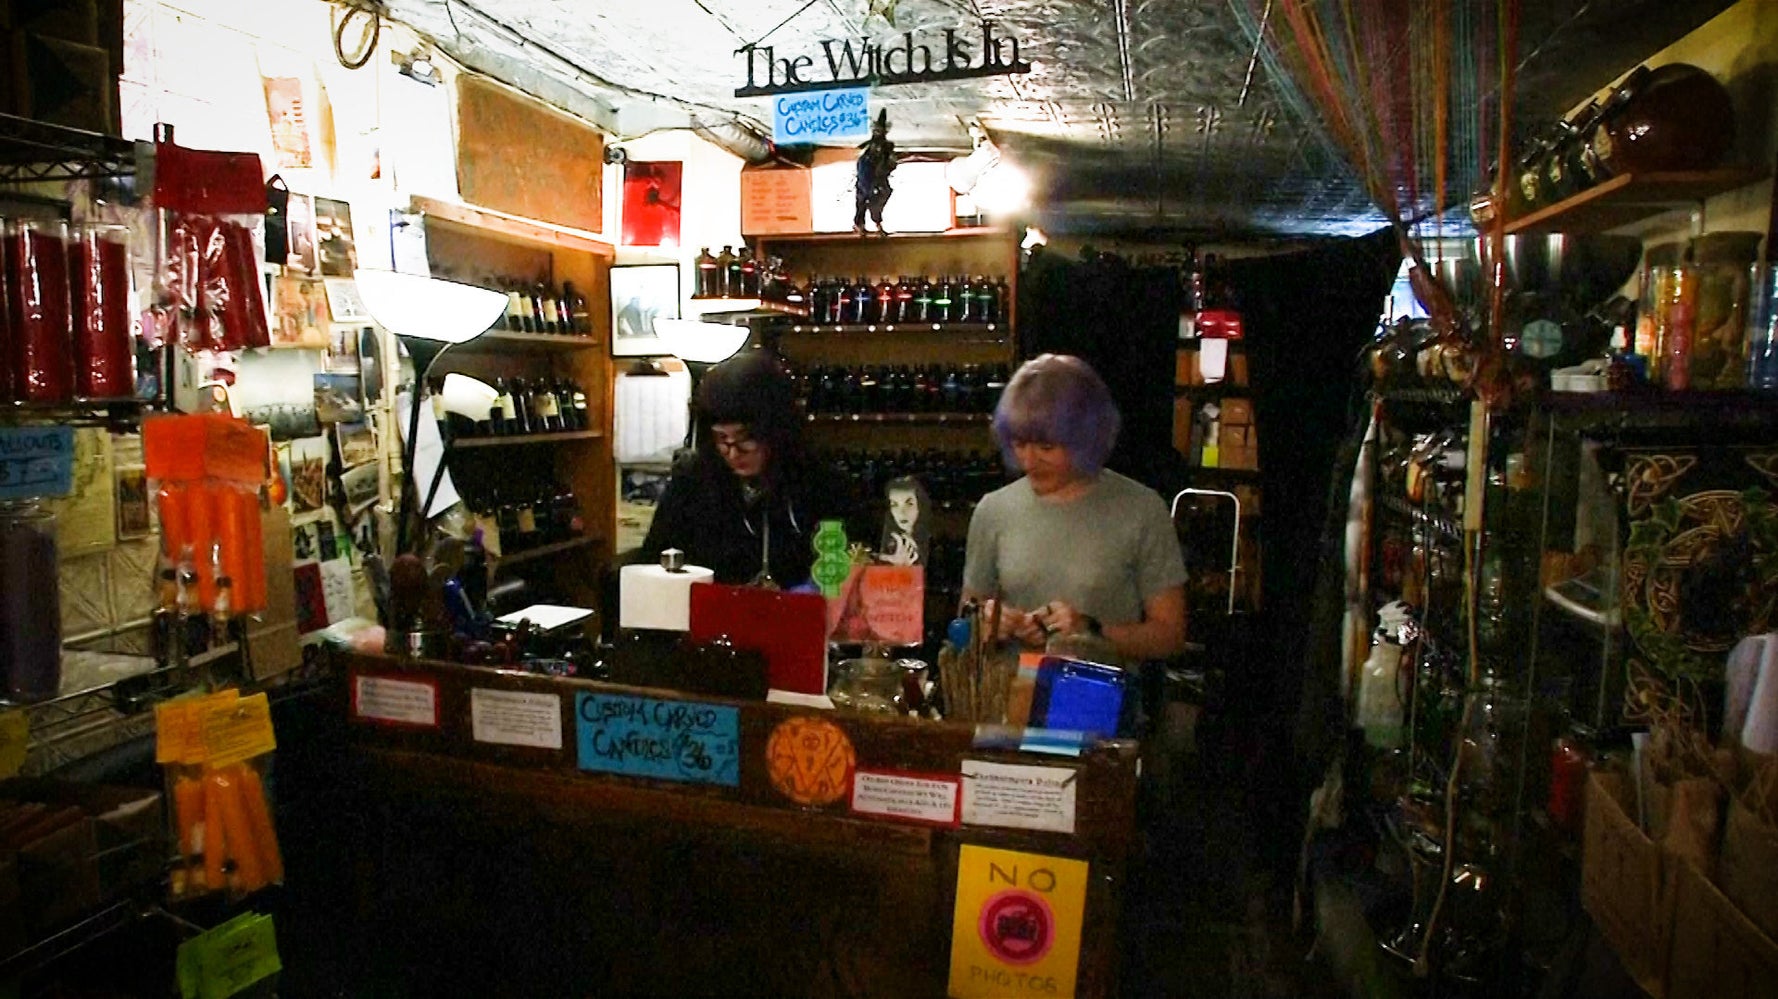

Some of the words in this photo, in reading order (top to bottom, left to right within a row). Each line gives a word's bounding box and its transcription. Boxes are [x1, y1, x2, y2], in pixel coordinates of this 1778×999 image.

[733, 43, 813, 88] The
[819, 32, 931, 80] Witch
[942, 29, 974, 70] Is
[980, 21, 1023, 66] In
[989, 862, 1056, 893] NO
[970, 965, 1058, 993] PHOTOS
